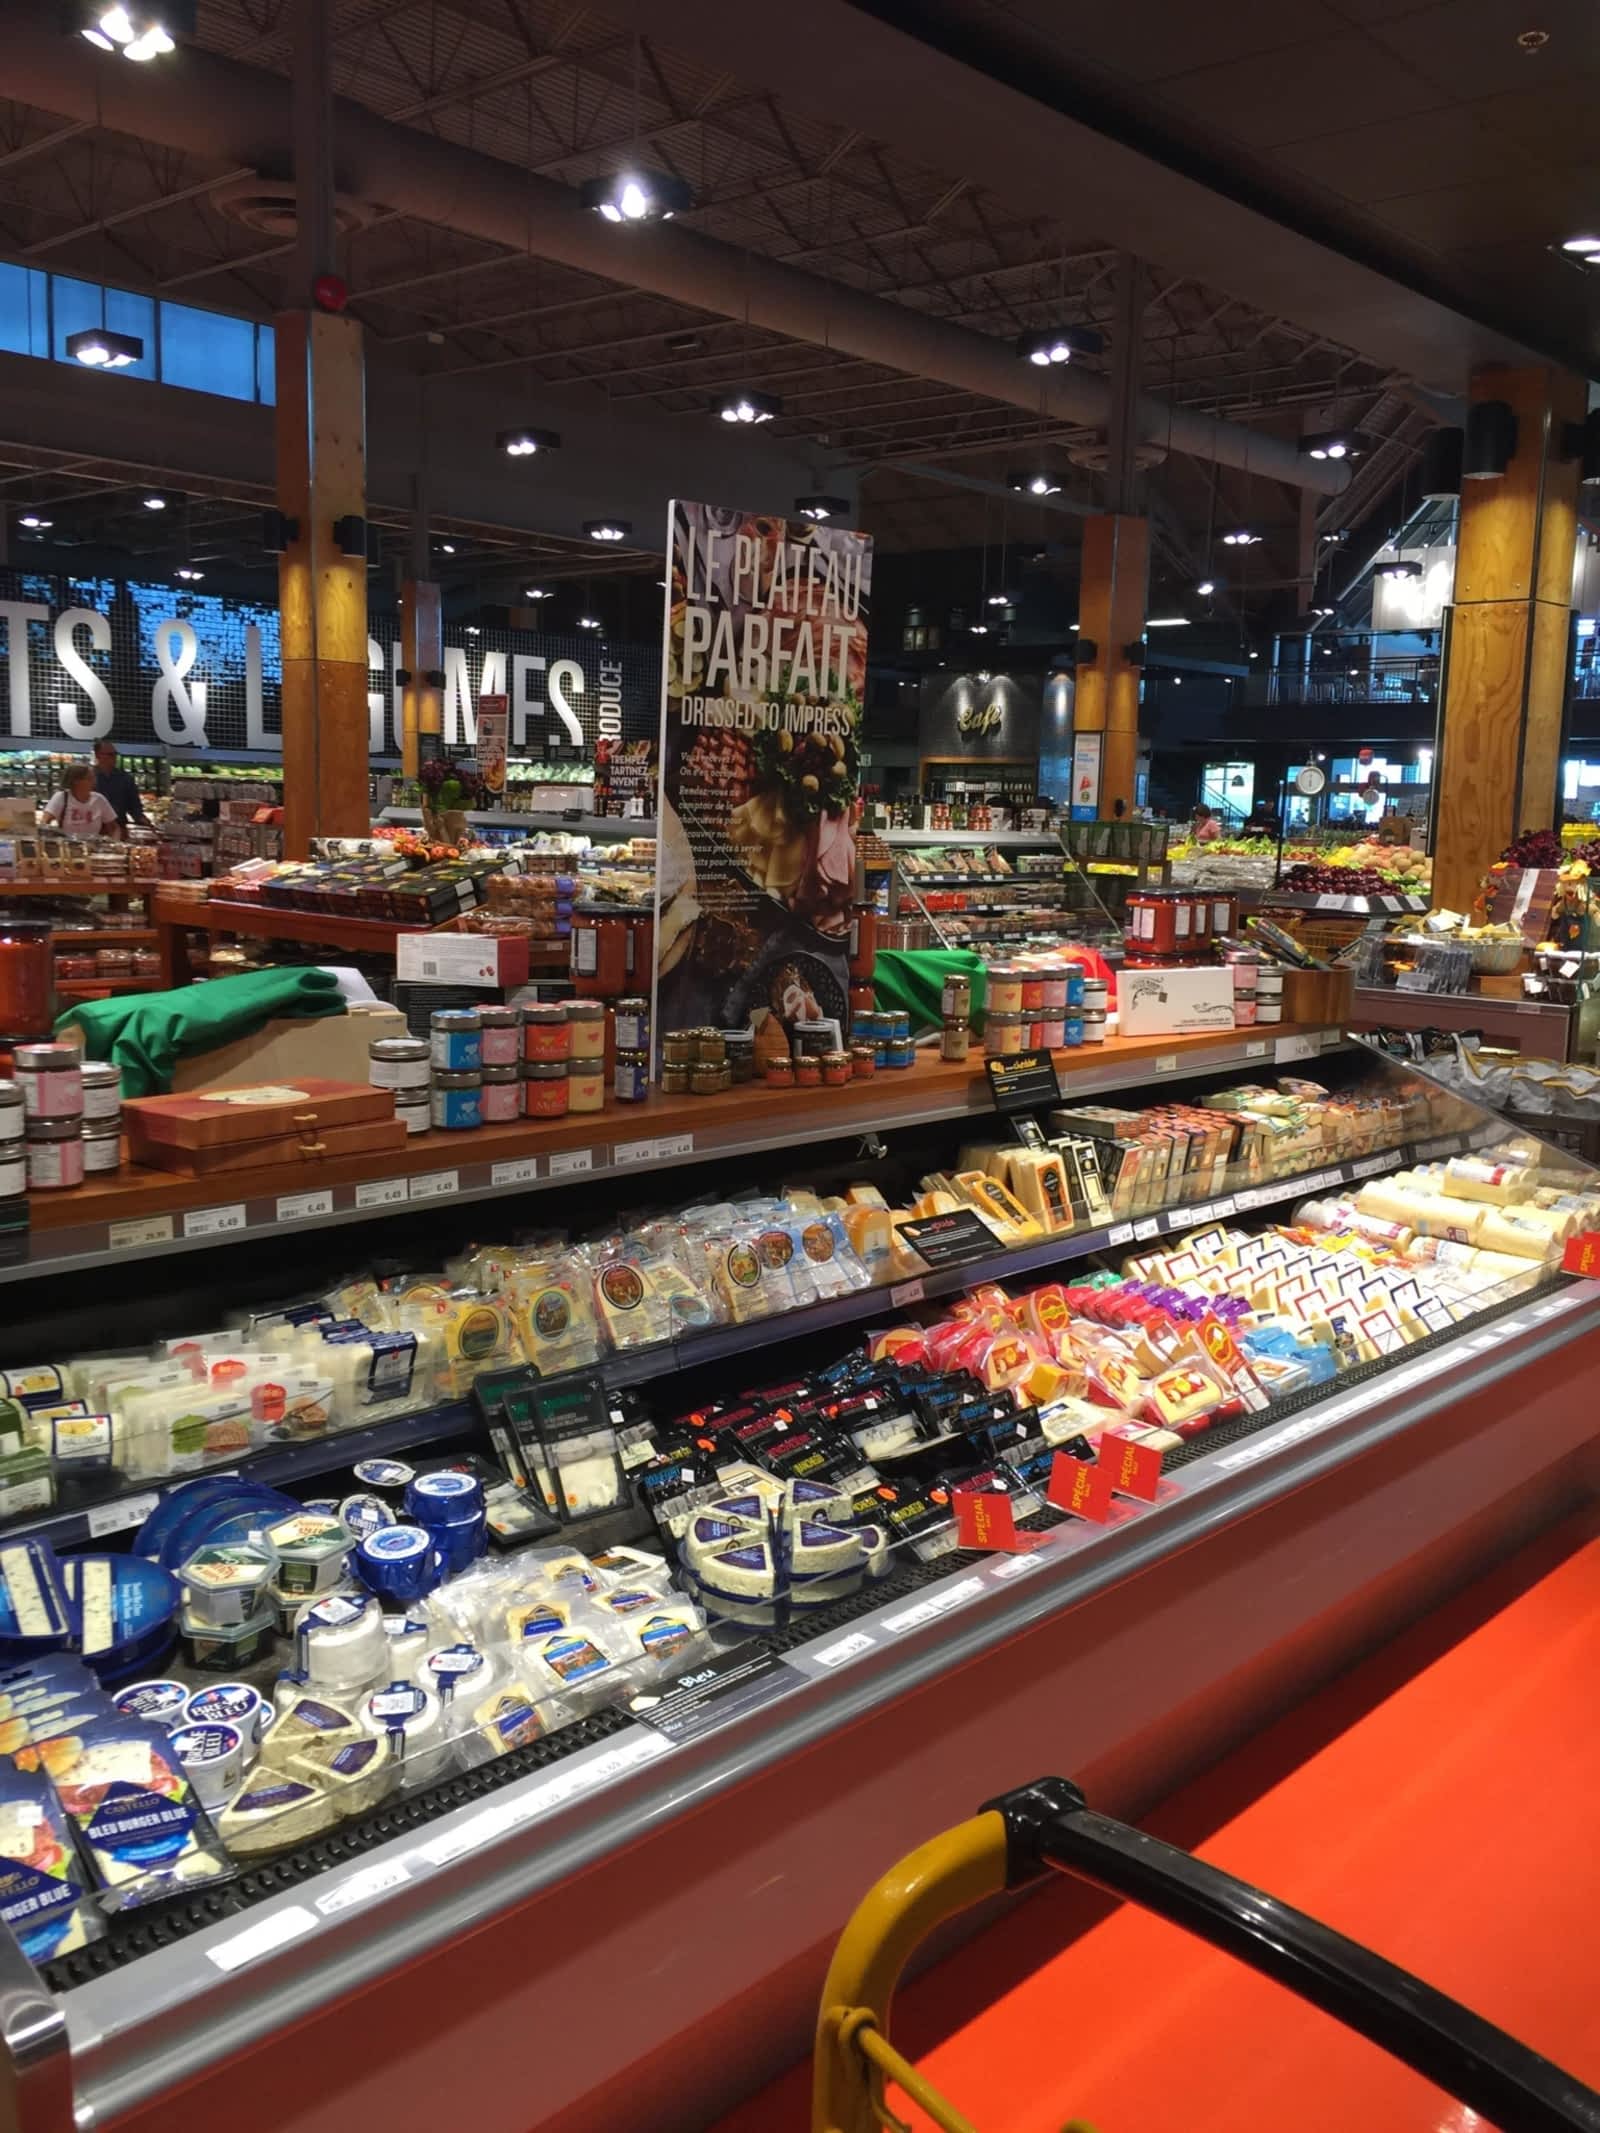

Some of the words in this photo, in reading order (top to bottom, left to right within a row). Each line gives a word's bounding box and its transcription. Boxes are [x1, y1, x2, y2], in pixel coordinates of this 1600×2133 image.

[687, 526, 722, 603] LE
[733, 534, 862, 621] PLATEAU
[682, 606, 857, 699] PARFAIT
[152, 618, 210, 748] &
[681, 696, 754, 730] DRESSED
[760, 702, 780, 731] TO
[783, 704, 850, 736] IMPRESS
[218, 1217, 238, 1229] 6.49
[203, 1701, 249, 1722] BLEU
[204, 1732, 223, 1758] BLEU
[103, 1798, 160, 1815] CASTELLO
[88, 1823, 118, 1839] BLEU
[117, 1812, 161, 1832] BURGER
[160, 1807, 190, 1822] BLUE
[37, 1883, 72, 1907] BLUE
